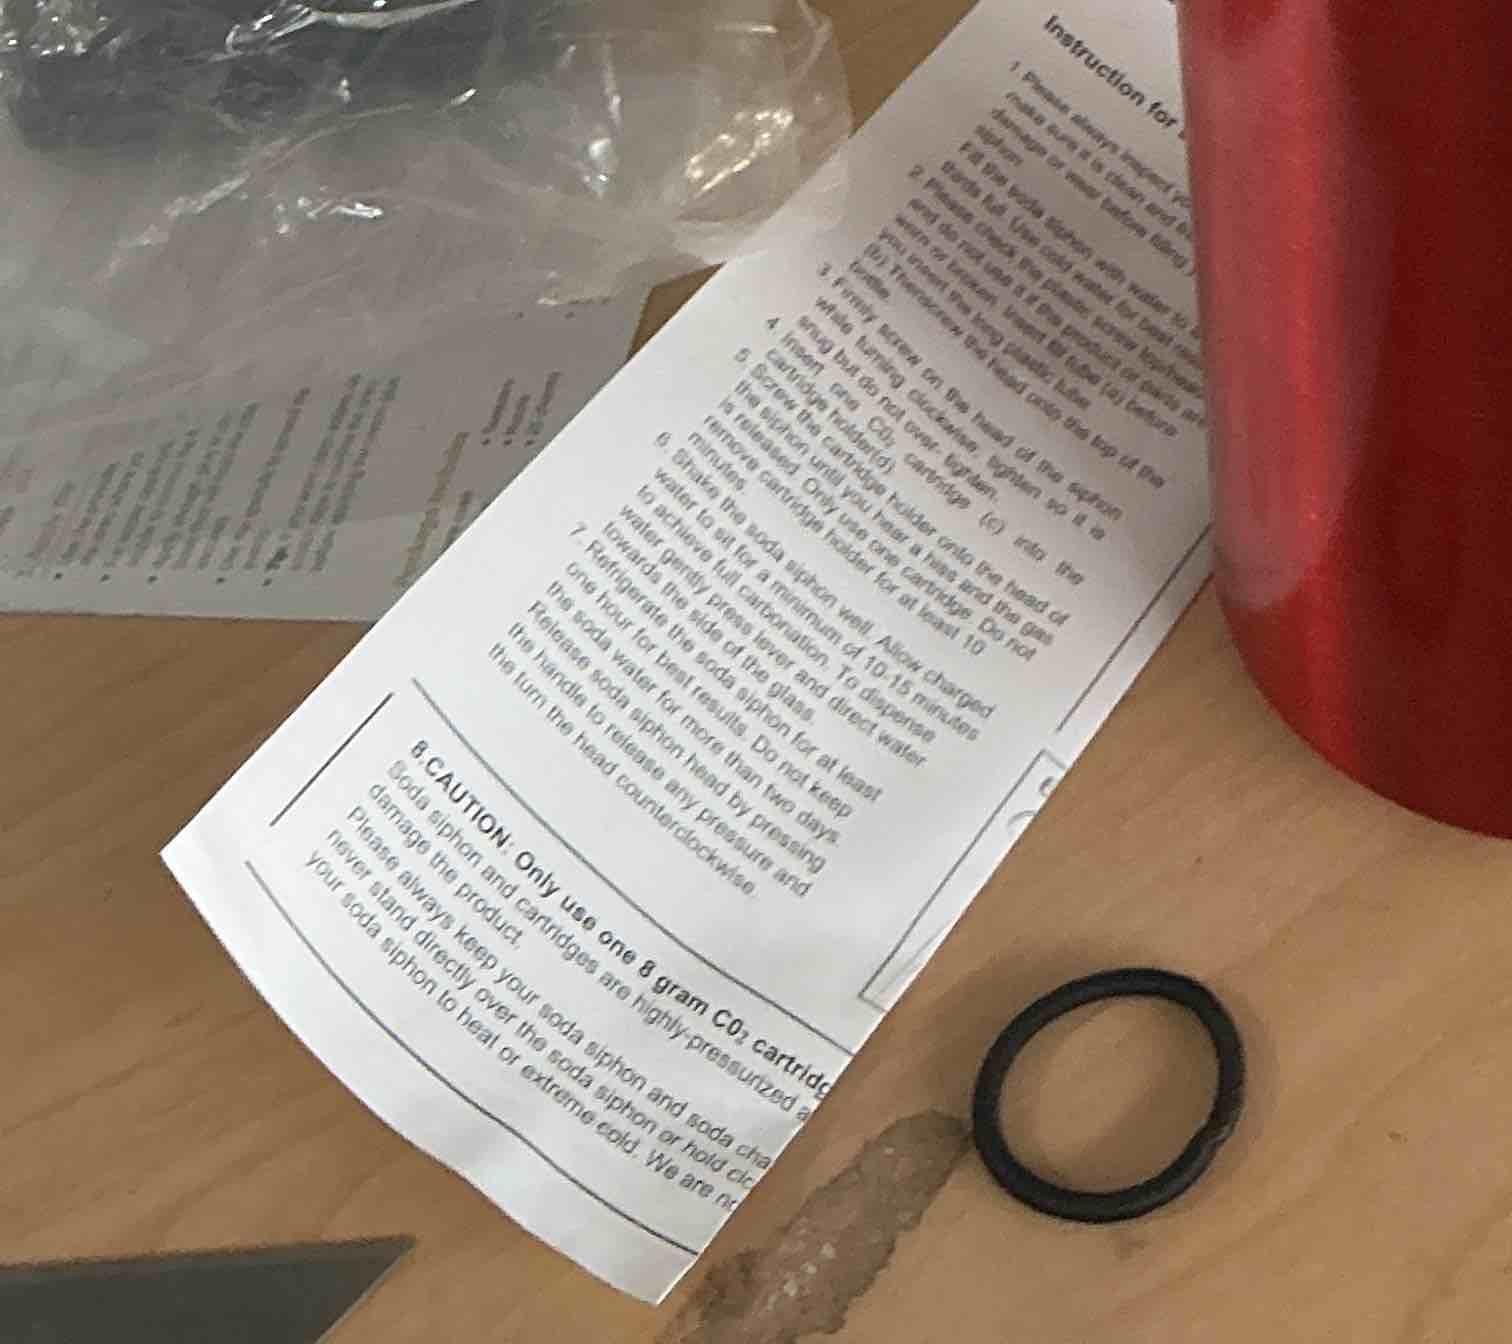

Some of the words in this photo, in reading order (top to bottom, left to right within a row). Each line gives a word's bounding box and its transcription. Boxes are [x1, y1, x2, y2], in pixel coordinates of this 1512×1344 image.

[1042, 14, 1148, 108] Instruction
[1144, 100, 1181, 132] for
[486, 640, 520, 676] the
[513, 668, 551, 710] turn
[545, 701, 578, 738] the
[572, 729, 620, 777] head
[506, 621, 538, 656] the
[531, 647, 592, 708] handle
[585, 700, 610, 727] to
[603, 718, 670, 782] release
[661, 777, 698, 813] any
[694, 806, 773, 876] pressure
[771, 863, 814, 899] and
[525, 599, 596, 672] Release
[589, 663, 634, 710] soda
[625, 702, 688, 764] siphon
[682, 751, 732, 799] head
[723, 790, 755, 822] by
[746, 808, 827, 877] pressing
[543, 579, 577, 614] the
[570, 606, 616, 653] soda
[609, 644, 660, 697] water
[654, 688, 685, 720] for
[679, 714, 725, 757] more
[721, 748, 767, 791] than
[760, 781, 800, 816] two
[563, 561, 597, 599] one
[594, 590, 636, 635] hour
[629, 626, 659, 657] for
[654, 648, 696, 691] best
[749, 733, 783, 766] Do
[776, 756, 811, 788] not
[802, 778, 855, 824] keep
[579, 538, 672, 633] Refrigerate
[666, 620, 700, 655] the
[693, 646, 740, 691] soda
[731, 682, 795, 742] siphon
[789, 729, 822, 759] for
[815, 748, 841, 773] at
[835, 763, 885, 803] least
[363, 777, 435, 862] damage
[427, 848, 462, 886] the
[386, 757, 435, 813] Soda
[422, 802, 486, 874] siphon
[478, 859, 520, 902] and
[509, 891, 604, 980] cartridges
[597, 970, 633, 1002] are
[626, 990, 801, 1117] highly-pressurized
[507, 847, 564, 905] Only
[557, 895, 598, 934] use
[595, 928, 638, 967] one
[636, 956, 659, 980] 8
[649, 973, 710, 1022] gram
[299, 850, 343, 900] your
[339, 886, 387, 941] soda
[375, 930, 442, 1001] siphon
[434, 987, 461, 1016] to
[454, 1005, 503, 1051] heat
[496, 1045, 521, 1068] or
[518, 1057, 601, 1127] extreme
[641, 1148, 682, 1184] We
[675, 1175, 713, 1203] are
[325, 828, 373, 883] never
[369, 874, 420, 933] stand
[409, 923, 481, 996] directly
[472, 985, 516, 1027] over
[513, 1017, 551, 1054] the
[545, 1043, 600, 1090] soda
[589, 1079, 663, 1139] siphon
[657, 1128, 683, 1150] or
[678, 1137, 730, 1176] hold
[345, 803, 406, 873] Please
[394, 863, 461, 934] always
[450, 919, 503, 977] keep
[491, 966, 539, 1013] your
[535, 998, 589, 1047] soda
[578, 1036, 652, 1097] siphon
[645, 1081, 691, 1119] and
[684, 1107, 739, 1151] soda
